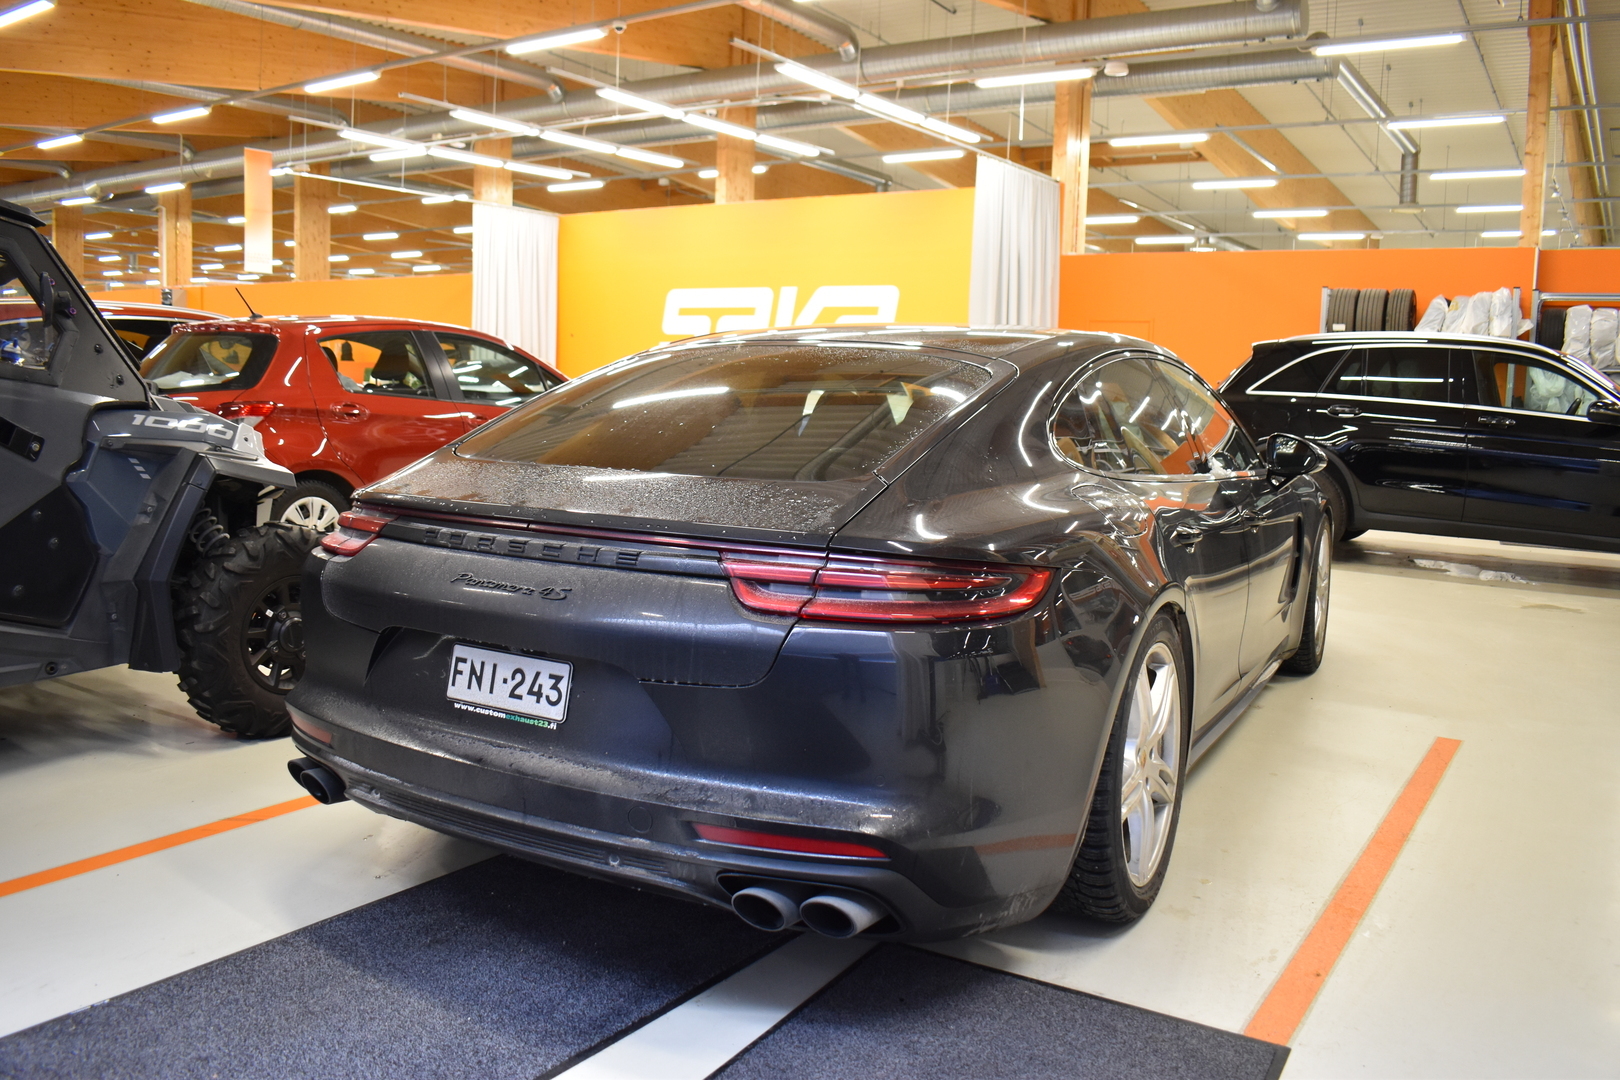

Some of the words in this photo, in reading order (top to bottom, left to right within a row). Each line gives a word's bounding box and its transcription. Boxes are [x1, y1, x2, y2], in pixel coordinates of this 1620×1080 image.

[424, 528, 643, 566] PORSCHE
[451, 572, 536, 596] Panamera
[537, 586, 572, 601] 4S
[453, 702, 558, 731] www.customexhaust23.fi
